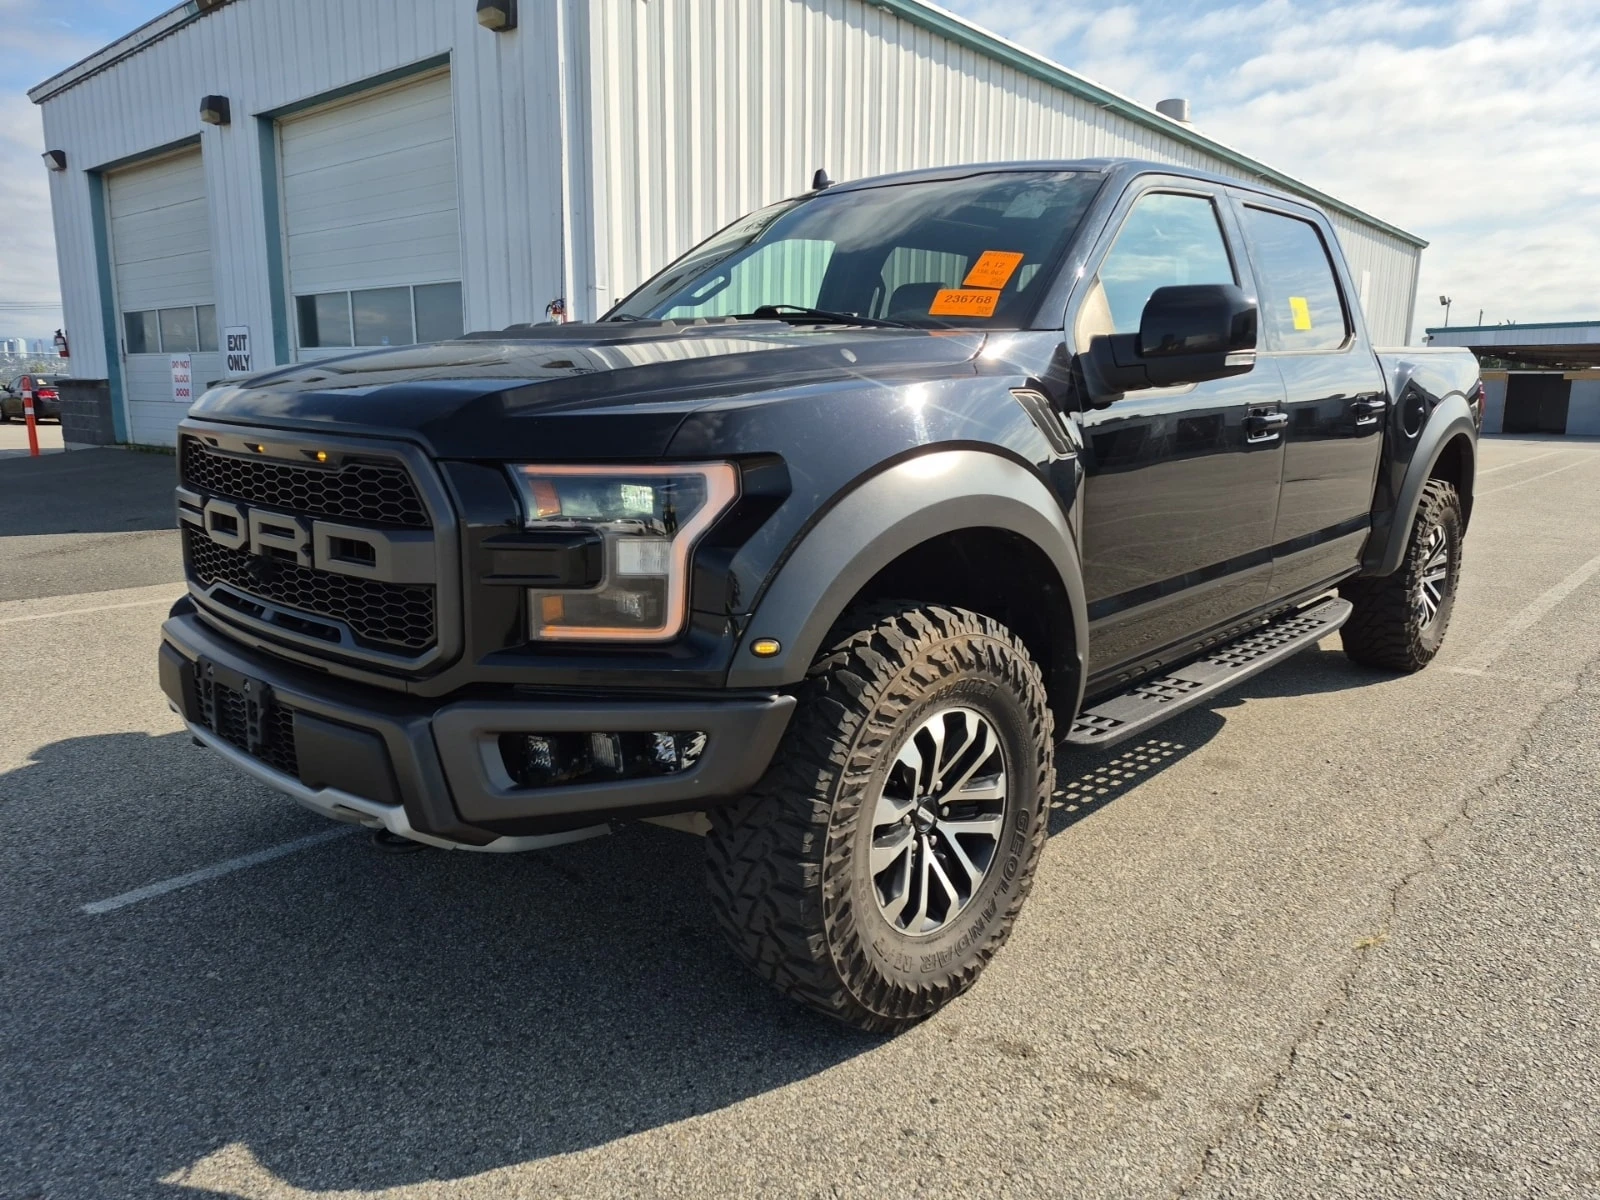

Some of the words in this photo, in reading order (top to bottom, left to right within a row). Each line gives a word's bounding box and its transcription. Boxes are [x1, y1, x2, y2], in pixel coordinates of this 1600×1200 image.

[944, 295, 992, 304] 236768
[228, 335, 247, 351] EXIT
[181, 360, 190, 368] NOT
[228, 355, 250, 371] ONLY
[174, 375, 189, 383] BLOCK
[176, 388, 190, 397] DOOR
[174, 485, 391, 583] FORD
[920, 807, 1031, 974] GEOLANDAR
